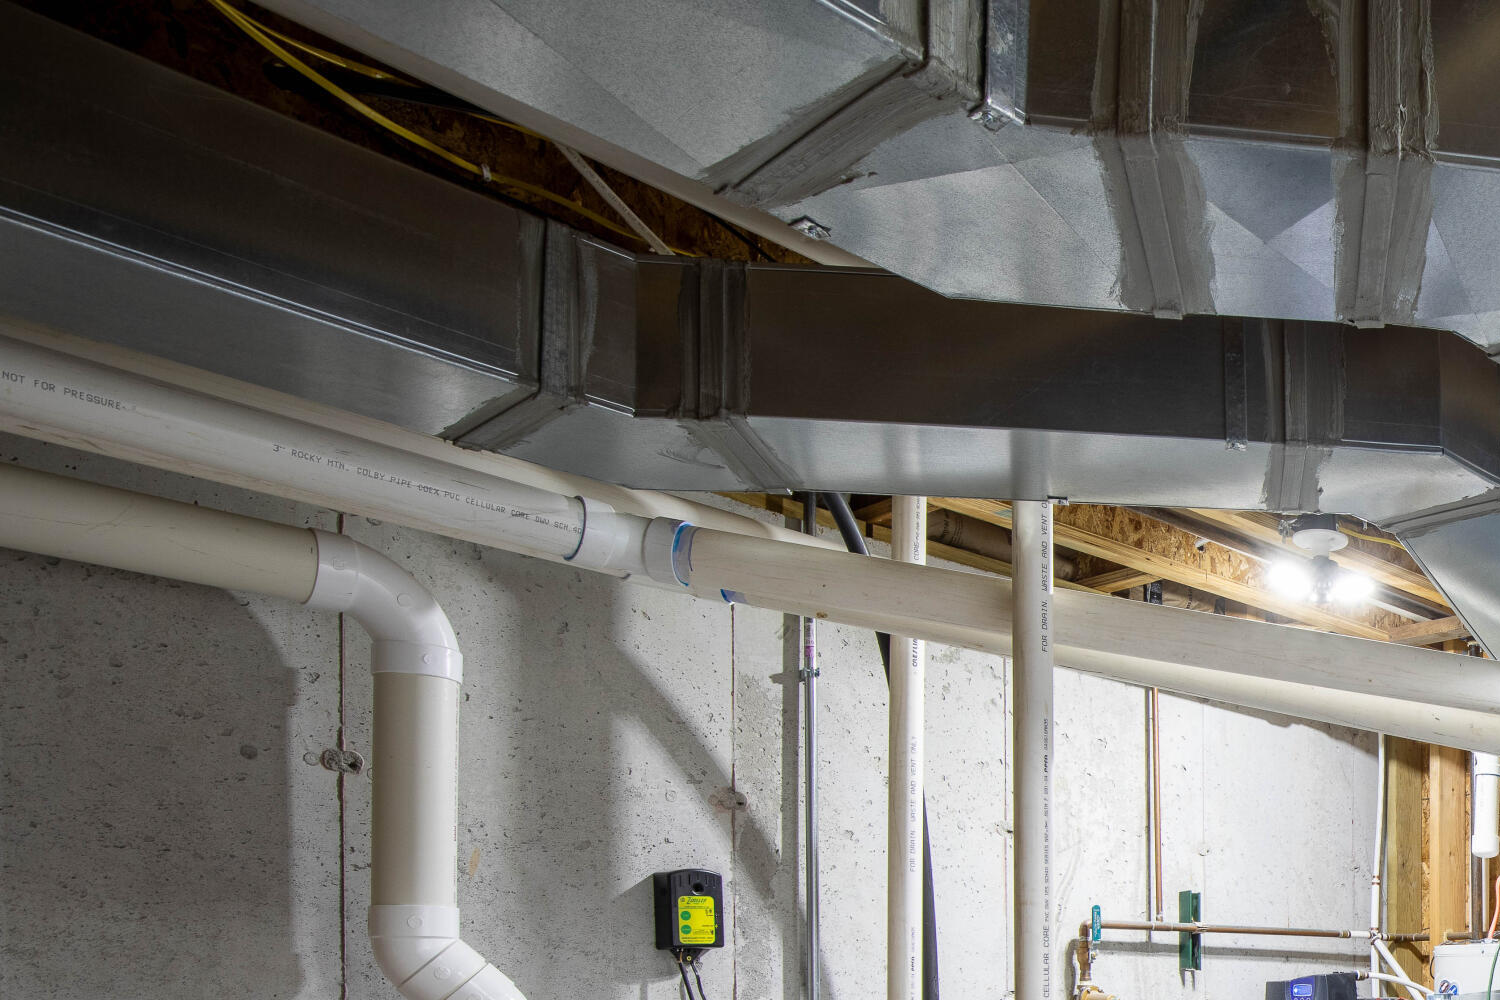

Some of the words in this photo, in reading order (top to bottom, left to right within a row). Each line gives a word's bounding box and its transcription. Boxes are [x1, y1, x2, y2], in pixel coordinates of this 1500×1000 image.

[2, 370, 25, 385] NOT
[34, 379, 56, 393] FOR
[291, 449, 322, 464] ROCKY
[356, 467, 386, 481] COLBY
[390, 475, 412, 488] PIPE
[465, 497, 506, 514] CELLULAR
